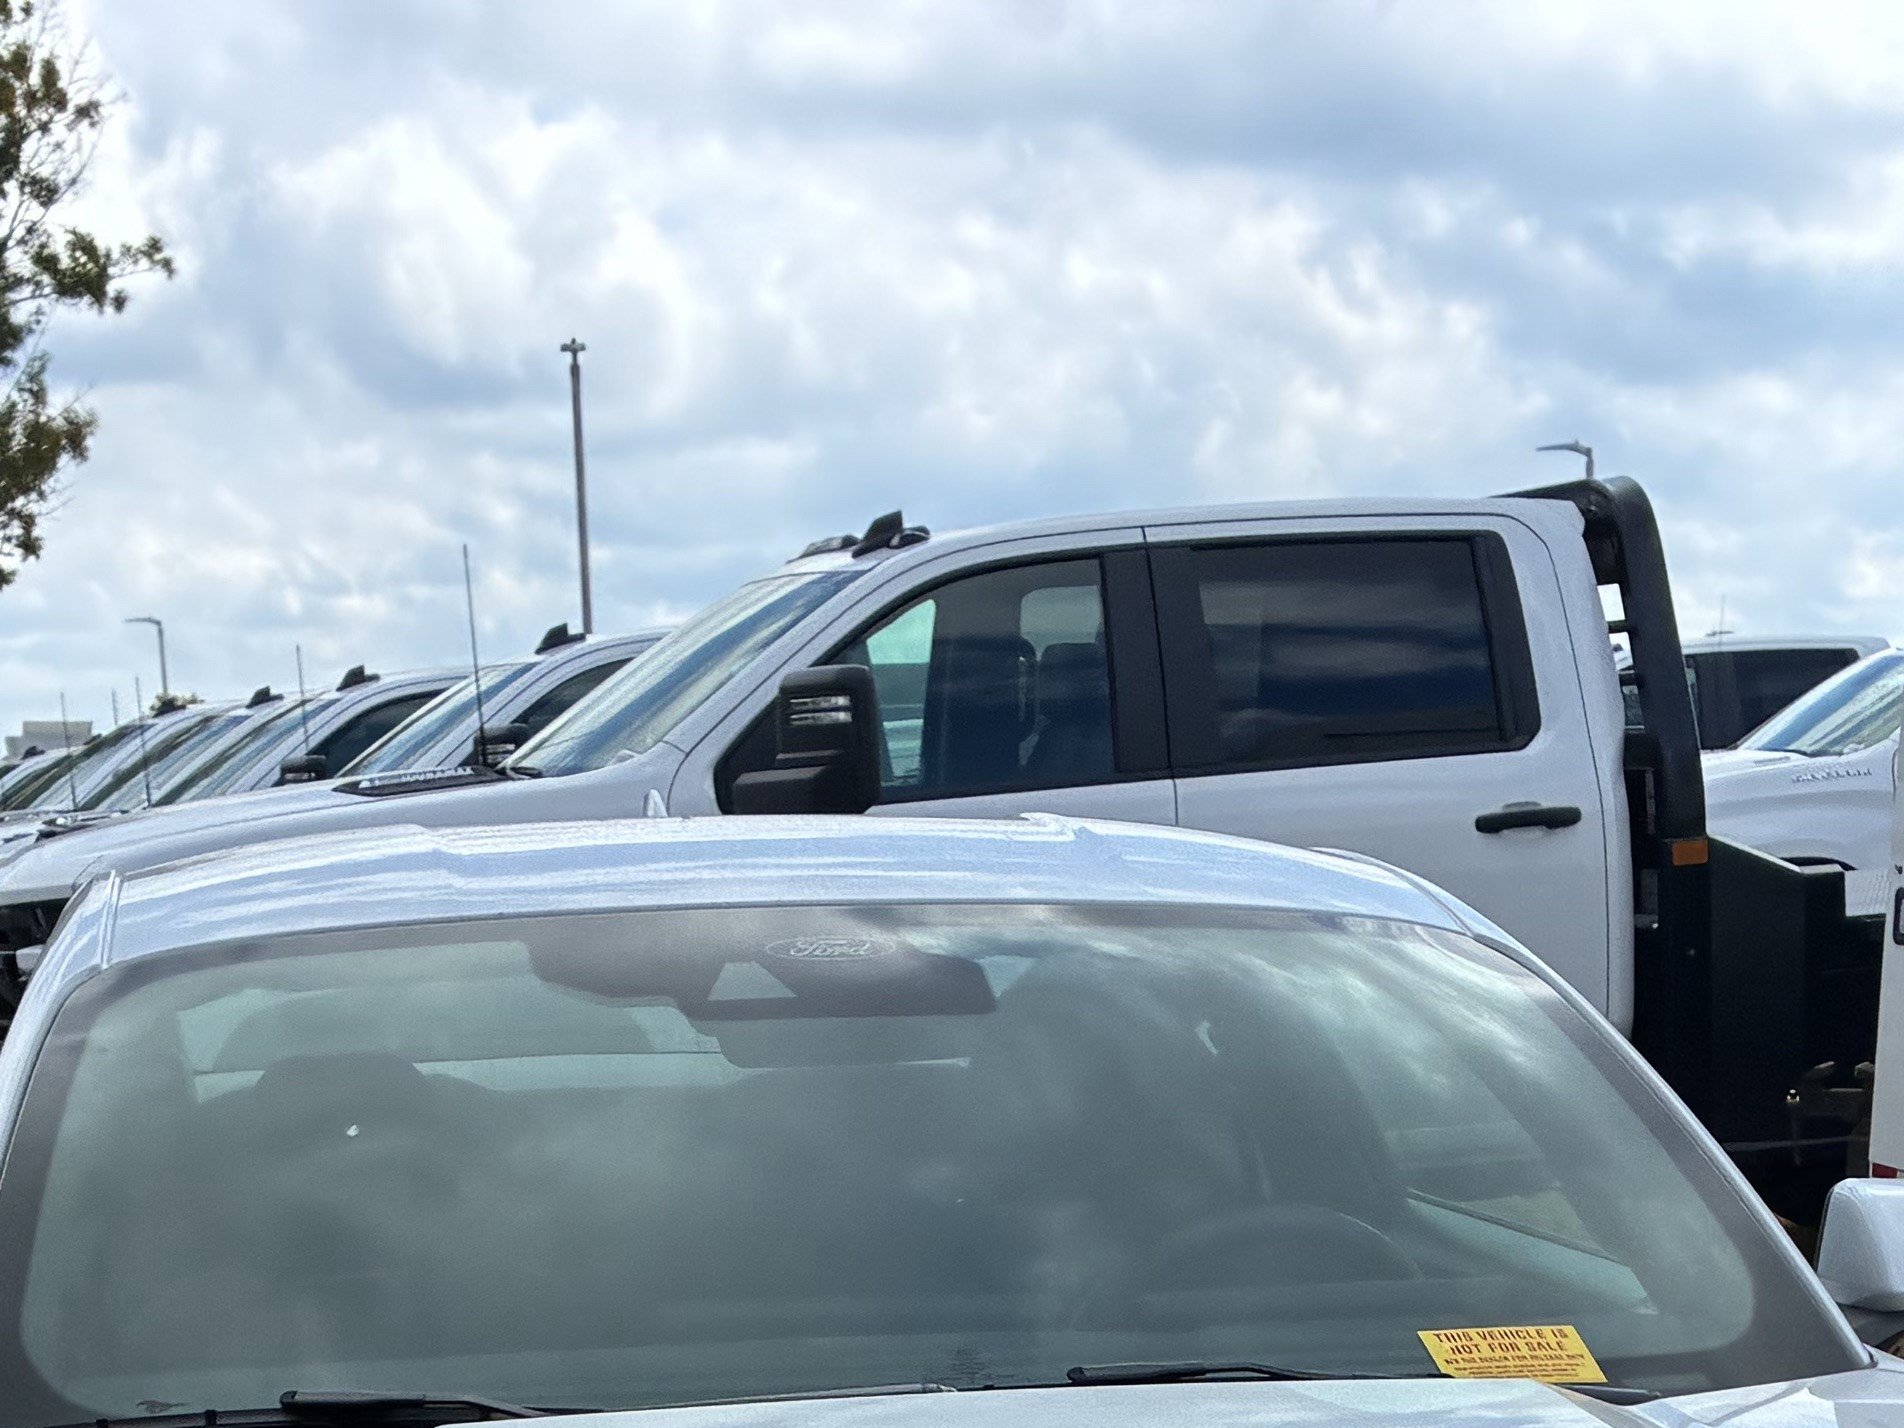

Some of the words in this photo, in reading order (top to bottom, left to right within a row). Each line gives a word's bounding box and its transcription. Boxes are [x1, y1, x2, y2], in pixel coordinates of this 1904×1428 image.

[1433, 1330, 1474, 1344] THIS
[1475, 1328, 1547, 1342] VEHICLE
[1550, 1327, 1569, 1339] IS
[1448, 1343, 1482, 1356] NOT
[1486, 1341, 1522, 1354] FOR
[1524, 1339, 1568, 1353] SALE
